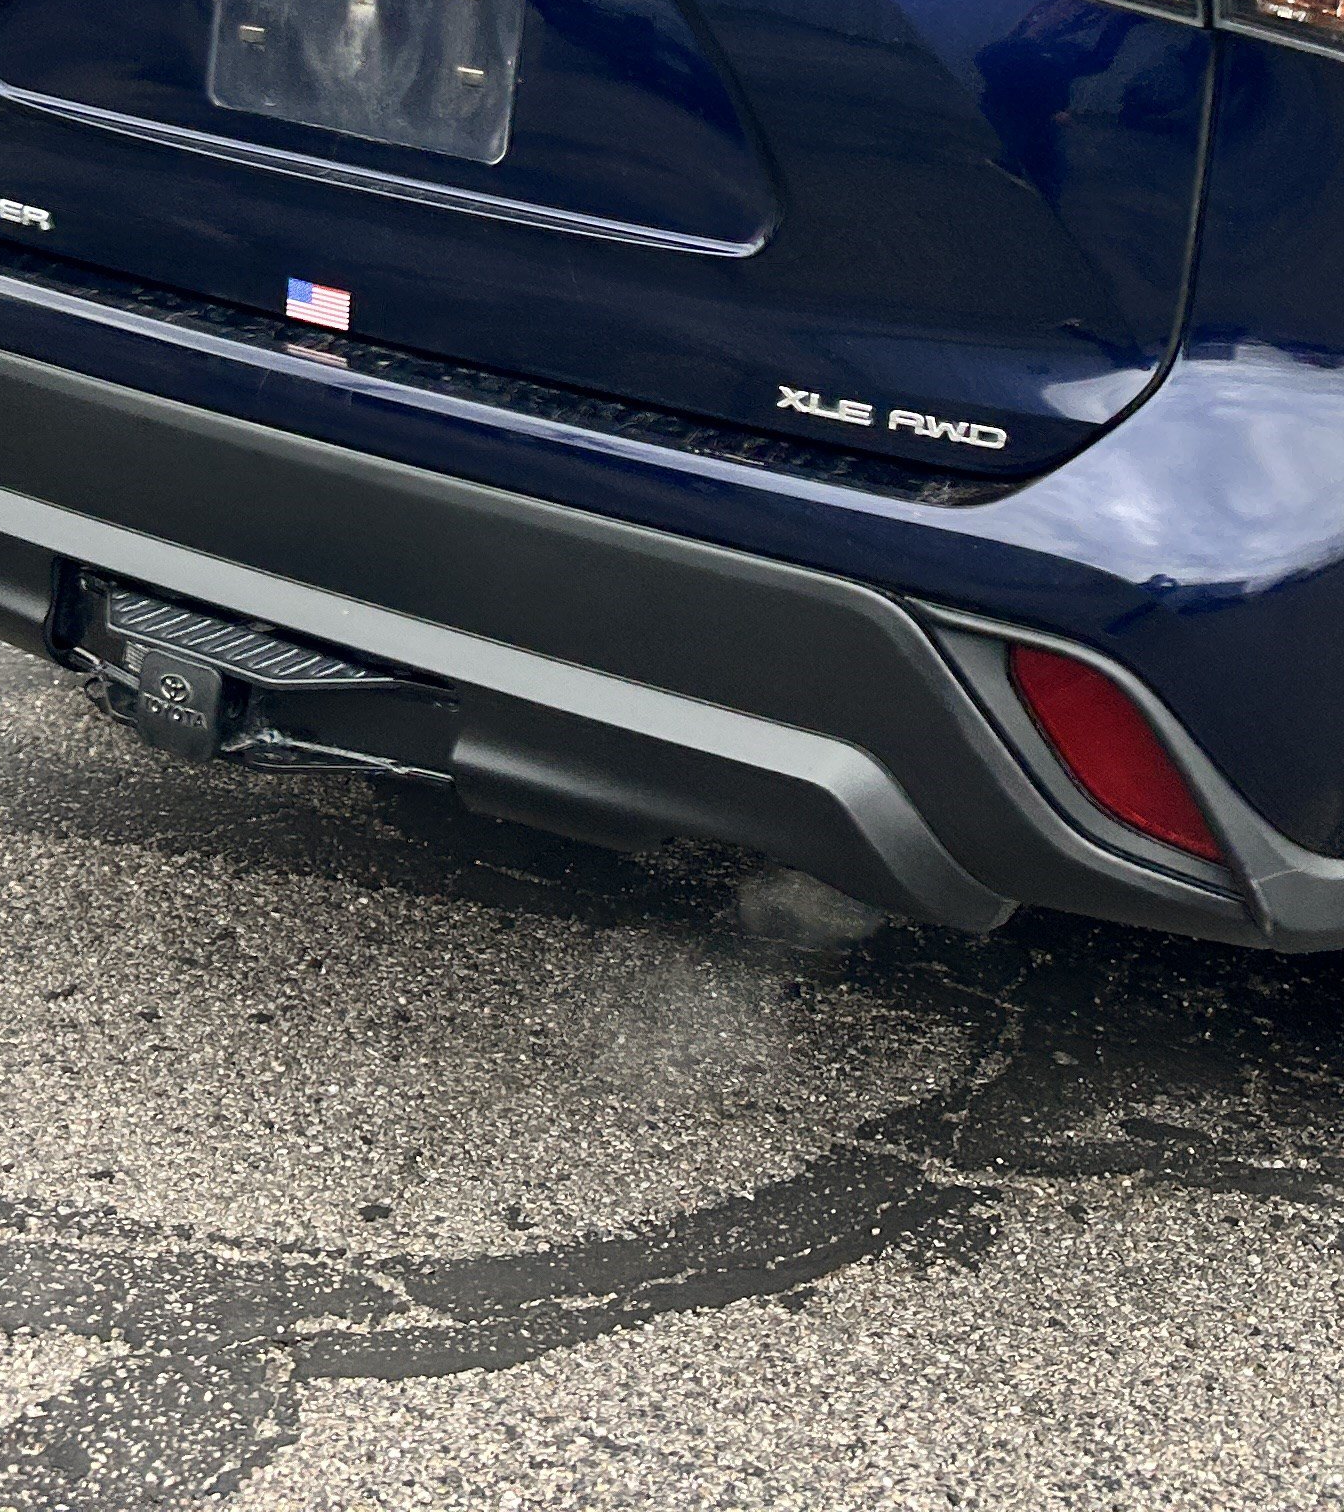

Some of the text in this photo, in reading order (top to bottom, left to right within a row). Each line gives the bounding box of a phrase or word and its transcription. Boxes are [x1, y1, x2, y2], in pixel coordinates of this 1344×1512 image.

[776, 385, 1008, 450] XLE AWD
[143, 691, 209, 730] TOYOTA
